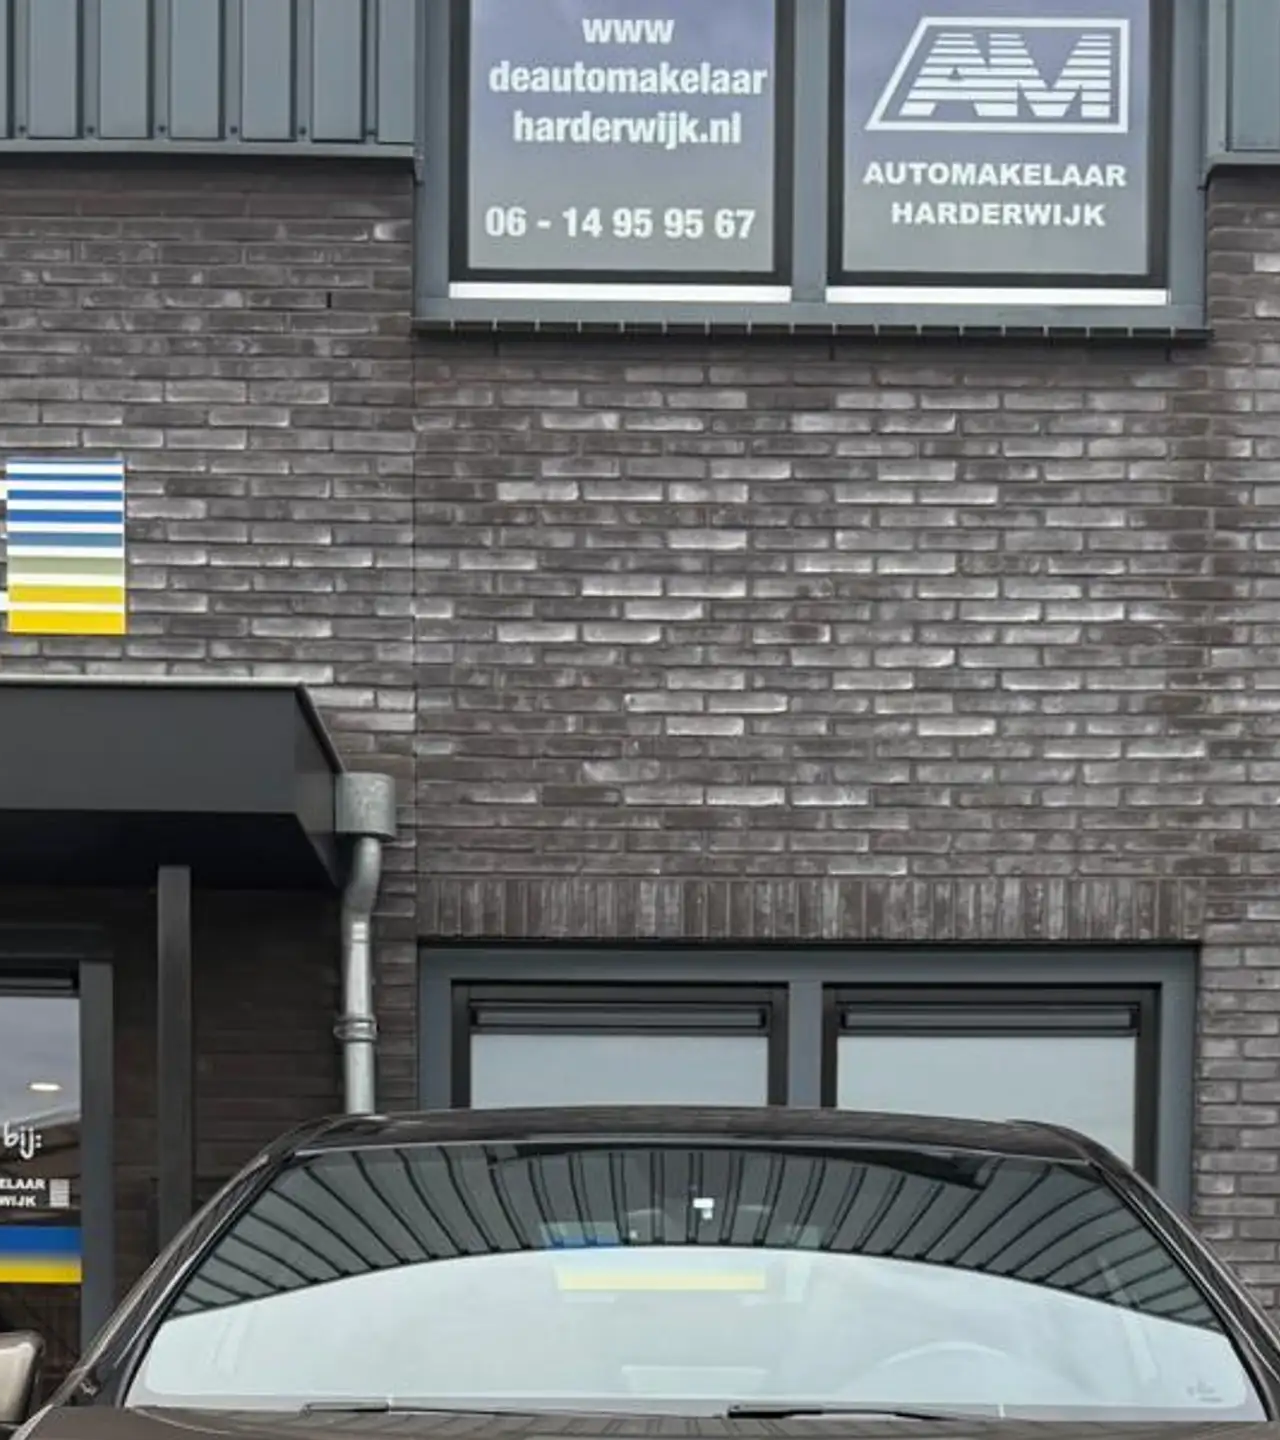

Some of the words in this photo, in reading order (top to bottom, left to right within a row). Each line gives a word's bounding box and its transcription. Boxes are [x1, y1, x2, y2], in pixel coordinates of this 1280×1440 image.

[582, 19, 675, 43] www
[489, 60, 768, 94] deautomakelaar
[899, 33, 1111, 118] AM
[514, 110, 742, 150] harderwijk.nl
[863, 161, 1127, 188] AUTOMAKELAAR
[485, 206, 526, 237] 06
[563, 207, 602, 237] 14
[612, 208, 653, 238] 95
[663, 208, 704, 238] 95
[714, 209, 756, 239] 67
[891, 201, 1106, 227] HARDERWIJK
[4, 1121, 42, 1159] bij:
